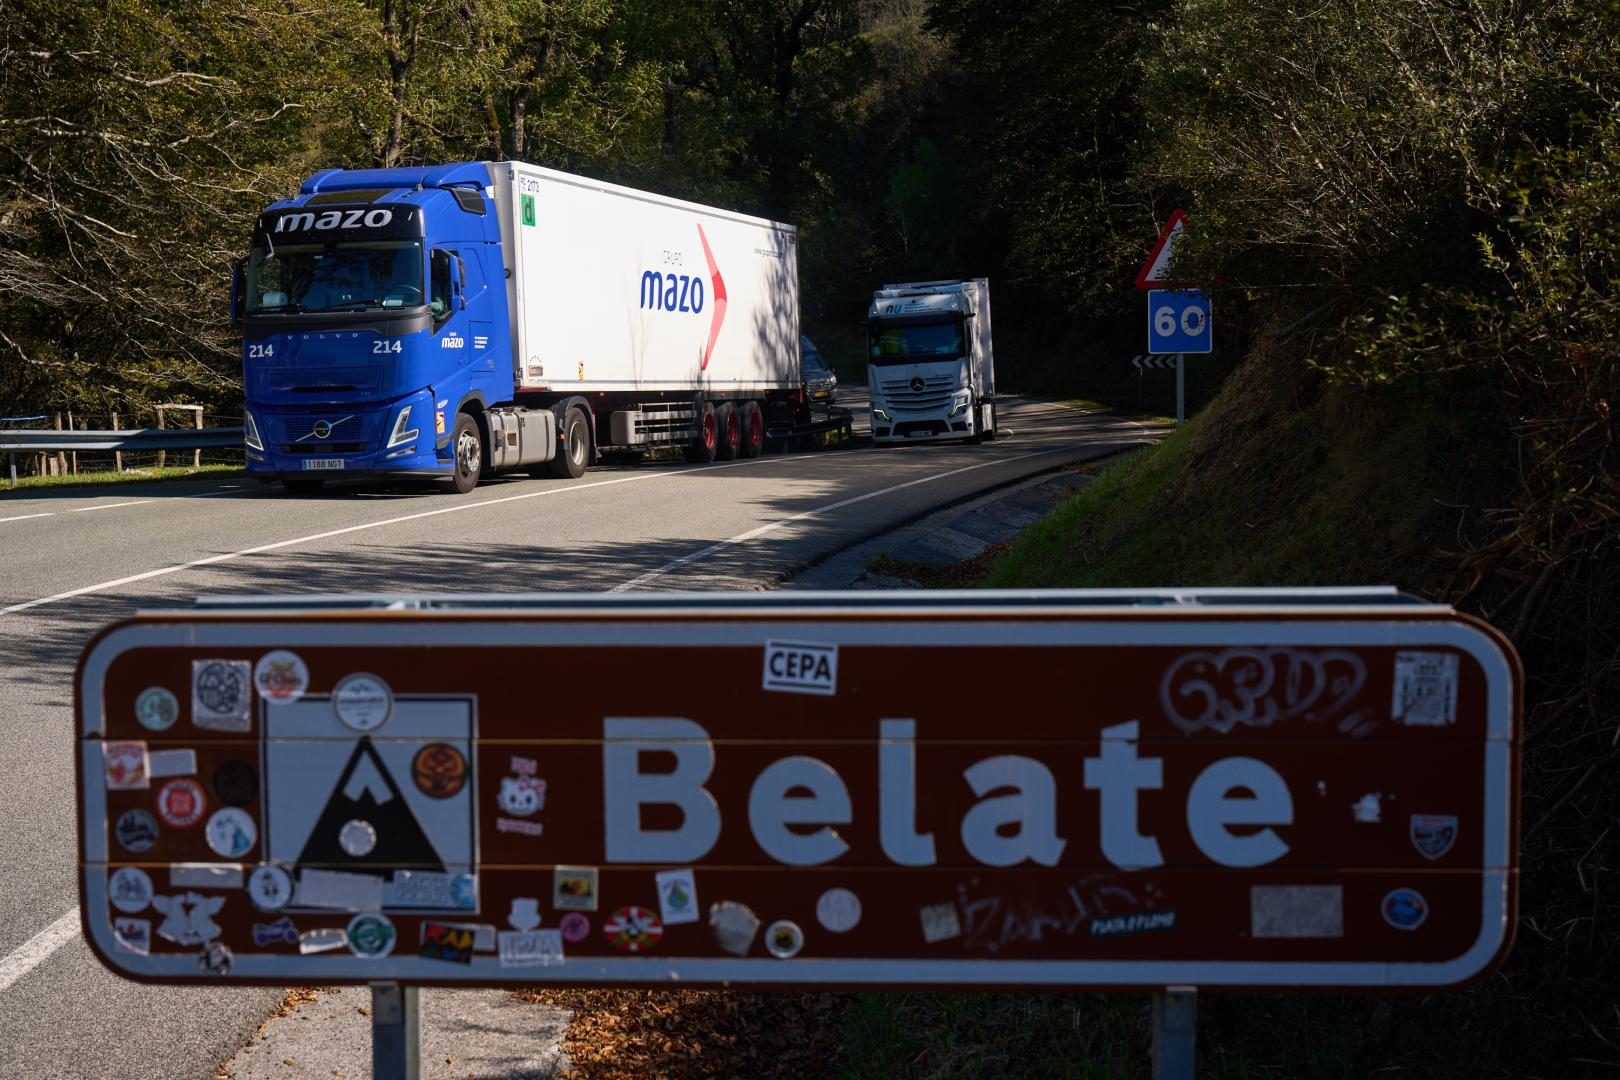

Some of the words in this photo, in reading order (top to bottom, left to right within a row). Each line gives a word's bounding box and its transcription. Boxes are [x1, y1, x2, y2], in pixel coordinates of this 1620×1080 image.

[274, 209, 393, 233] mazo
[640, 270, 704, 314] mazo
[1154, 306, 1206, 337] 60
[249, 344, 274, 358] 214
[372, 340, 403, 354] 214
[441, 337, 464, 349] mazo
[769, 650, 832, 683] CEPA
[603, 716, 1294, 871] Belate
